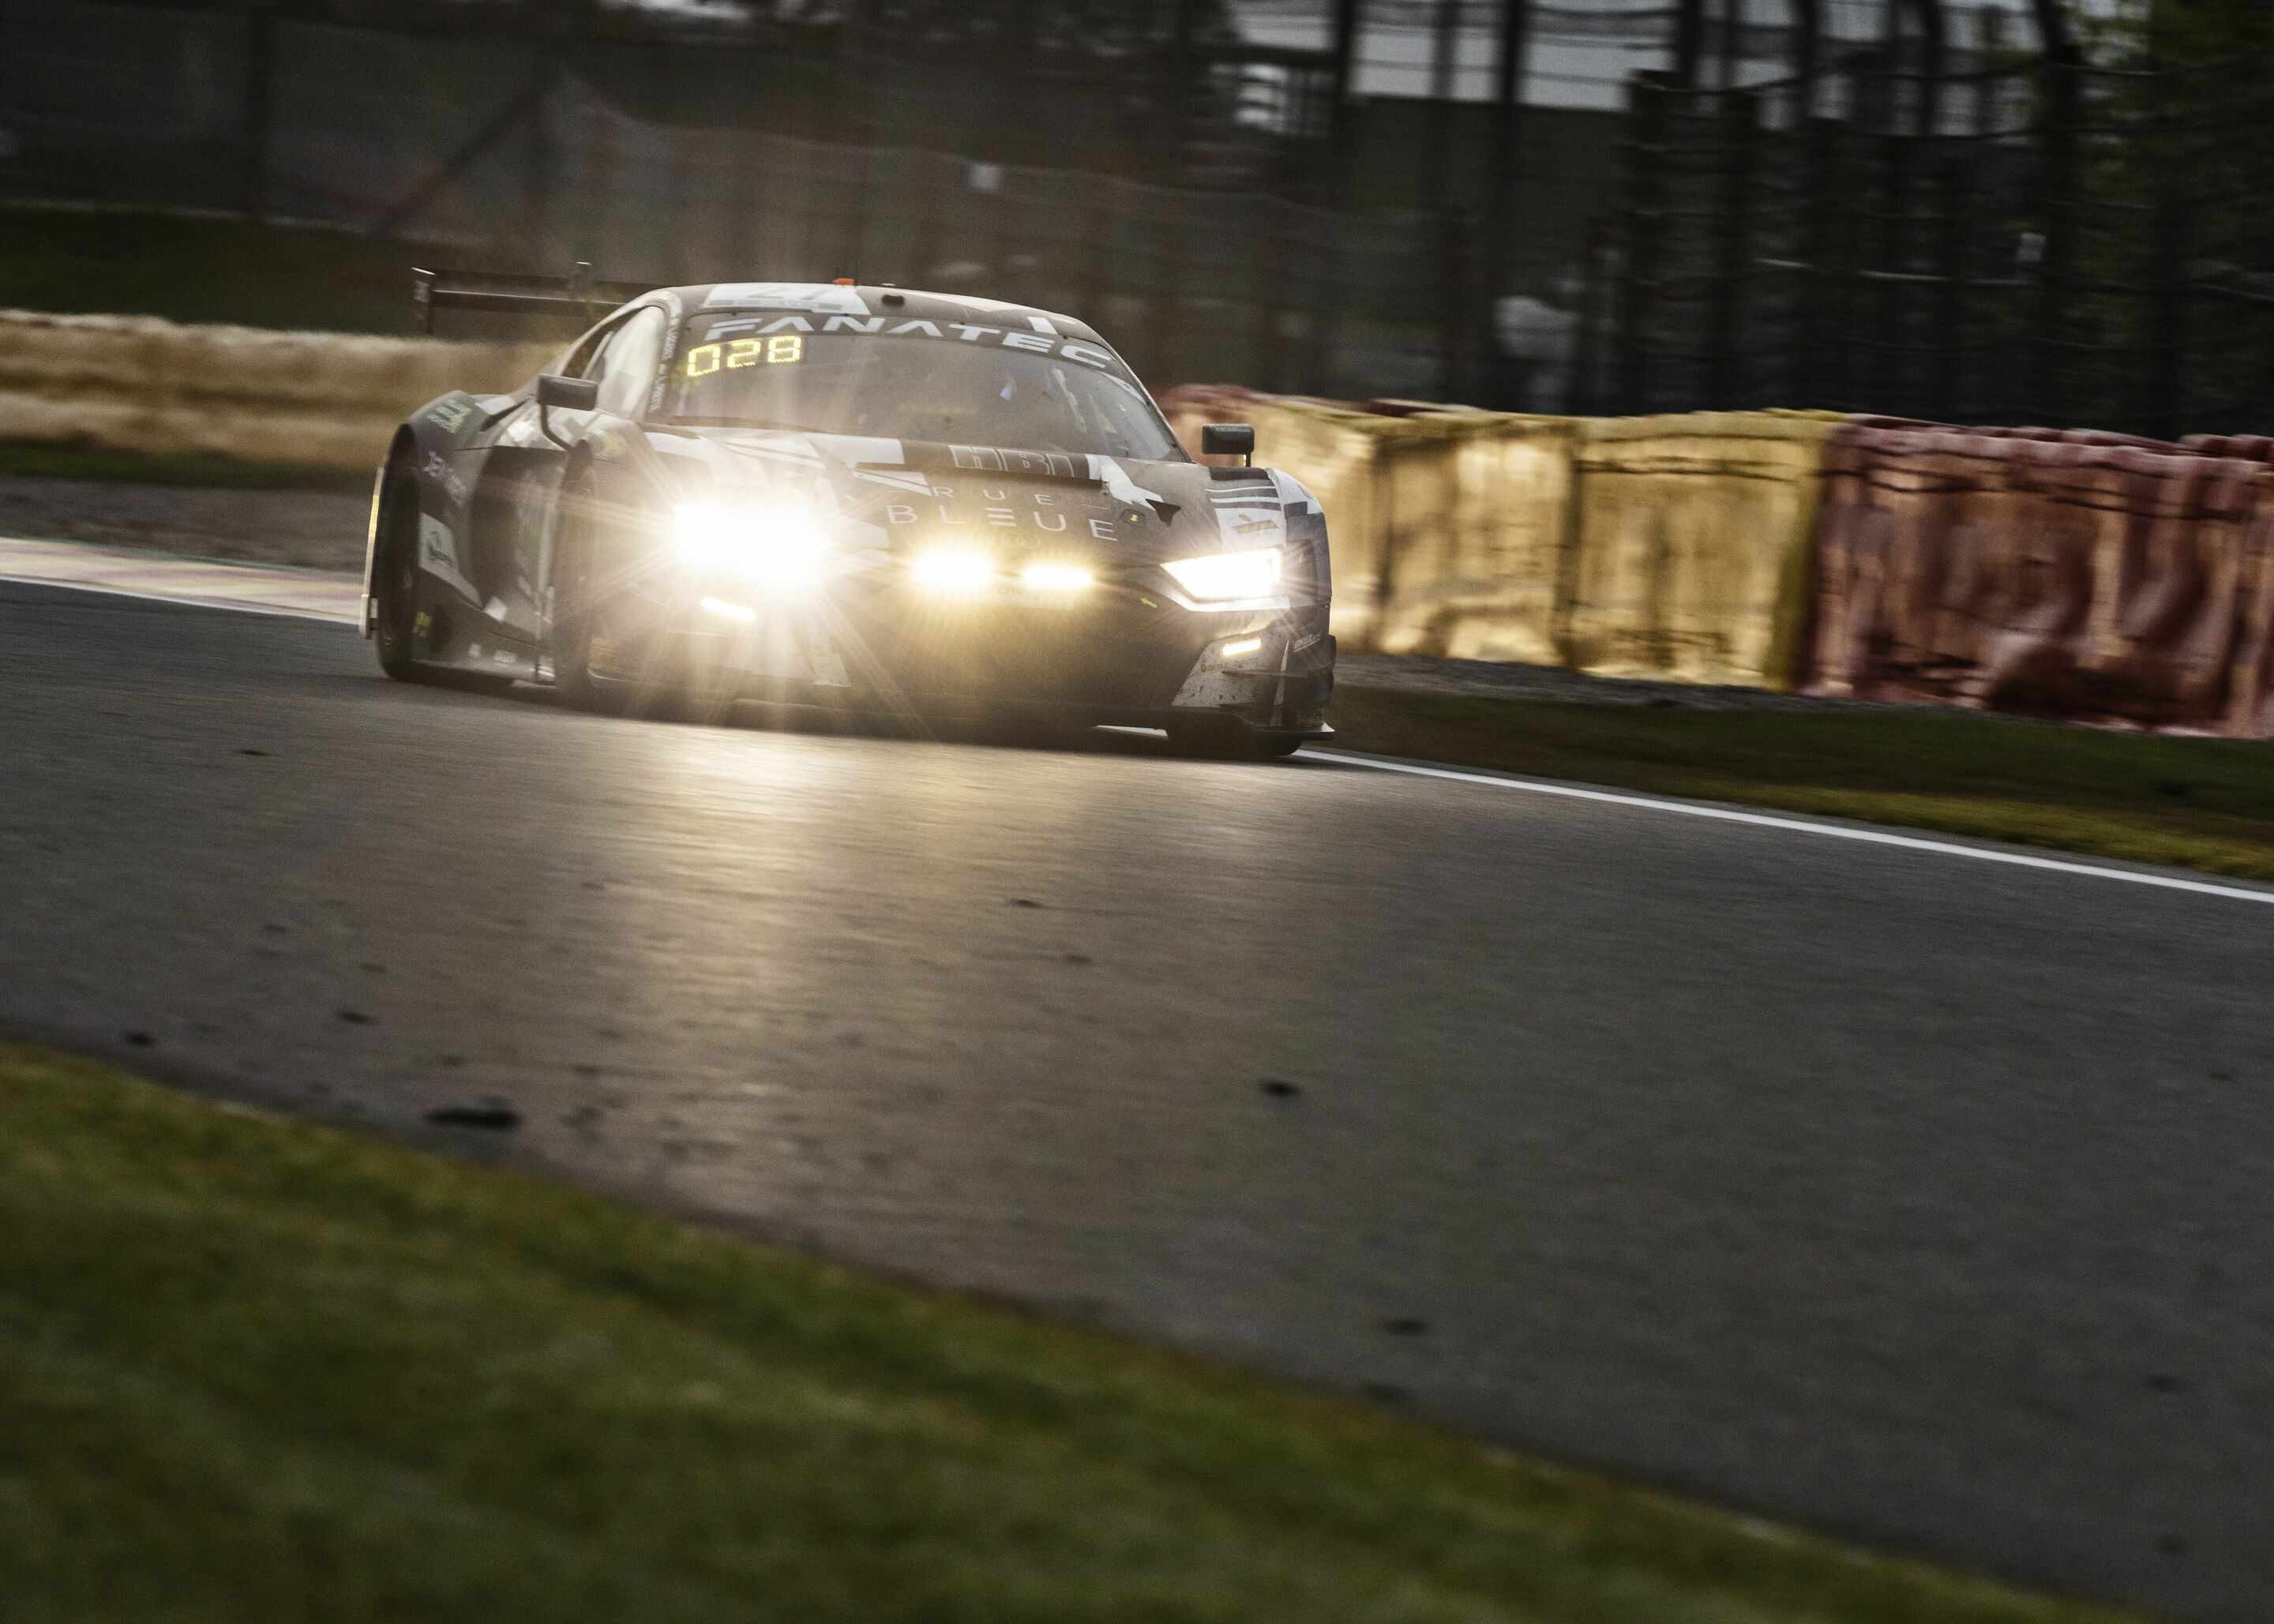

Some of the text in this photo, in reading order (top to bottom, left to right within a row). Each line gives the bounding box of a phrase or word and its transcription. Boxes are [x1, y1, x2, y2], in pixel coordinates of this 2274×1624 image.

[687, 335, 801, 377] 028
[704, 316, 1113, 369] FANATEC
[932, 486, 1055, 506] RUE
[886, 504, 1118, 542] BLEUE
